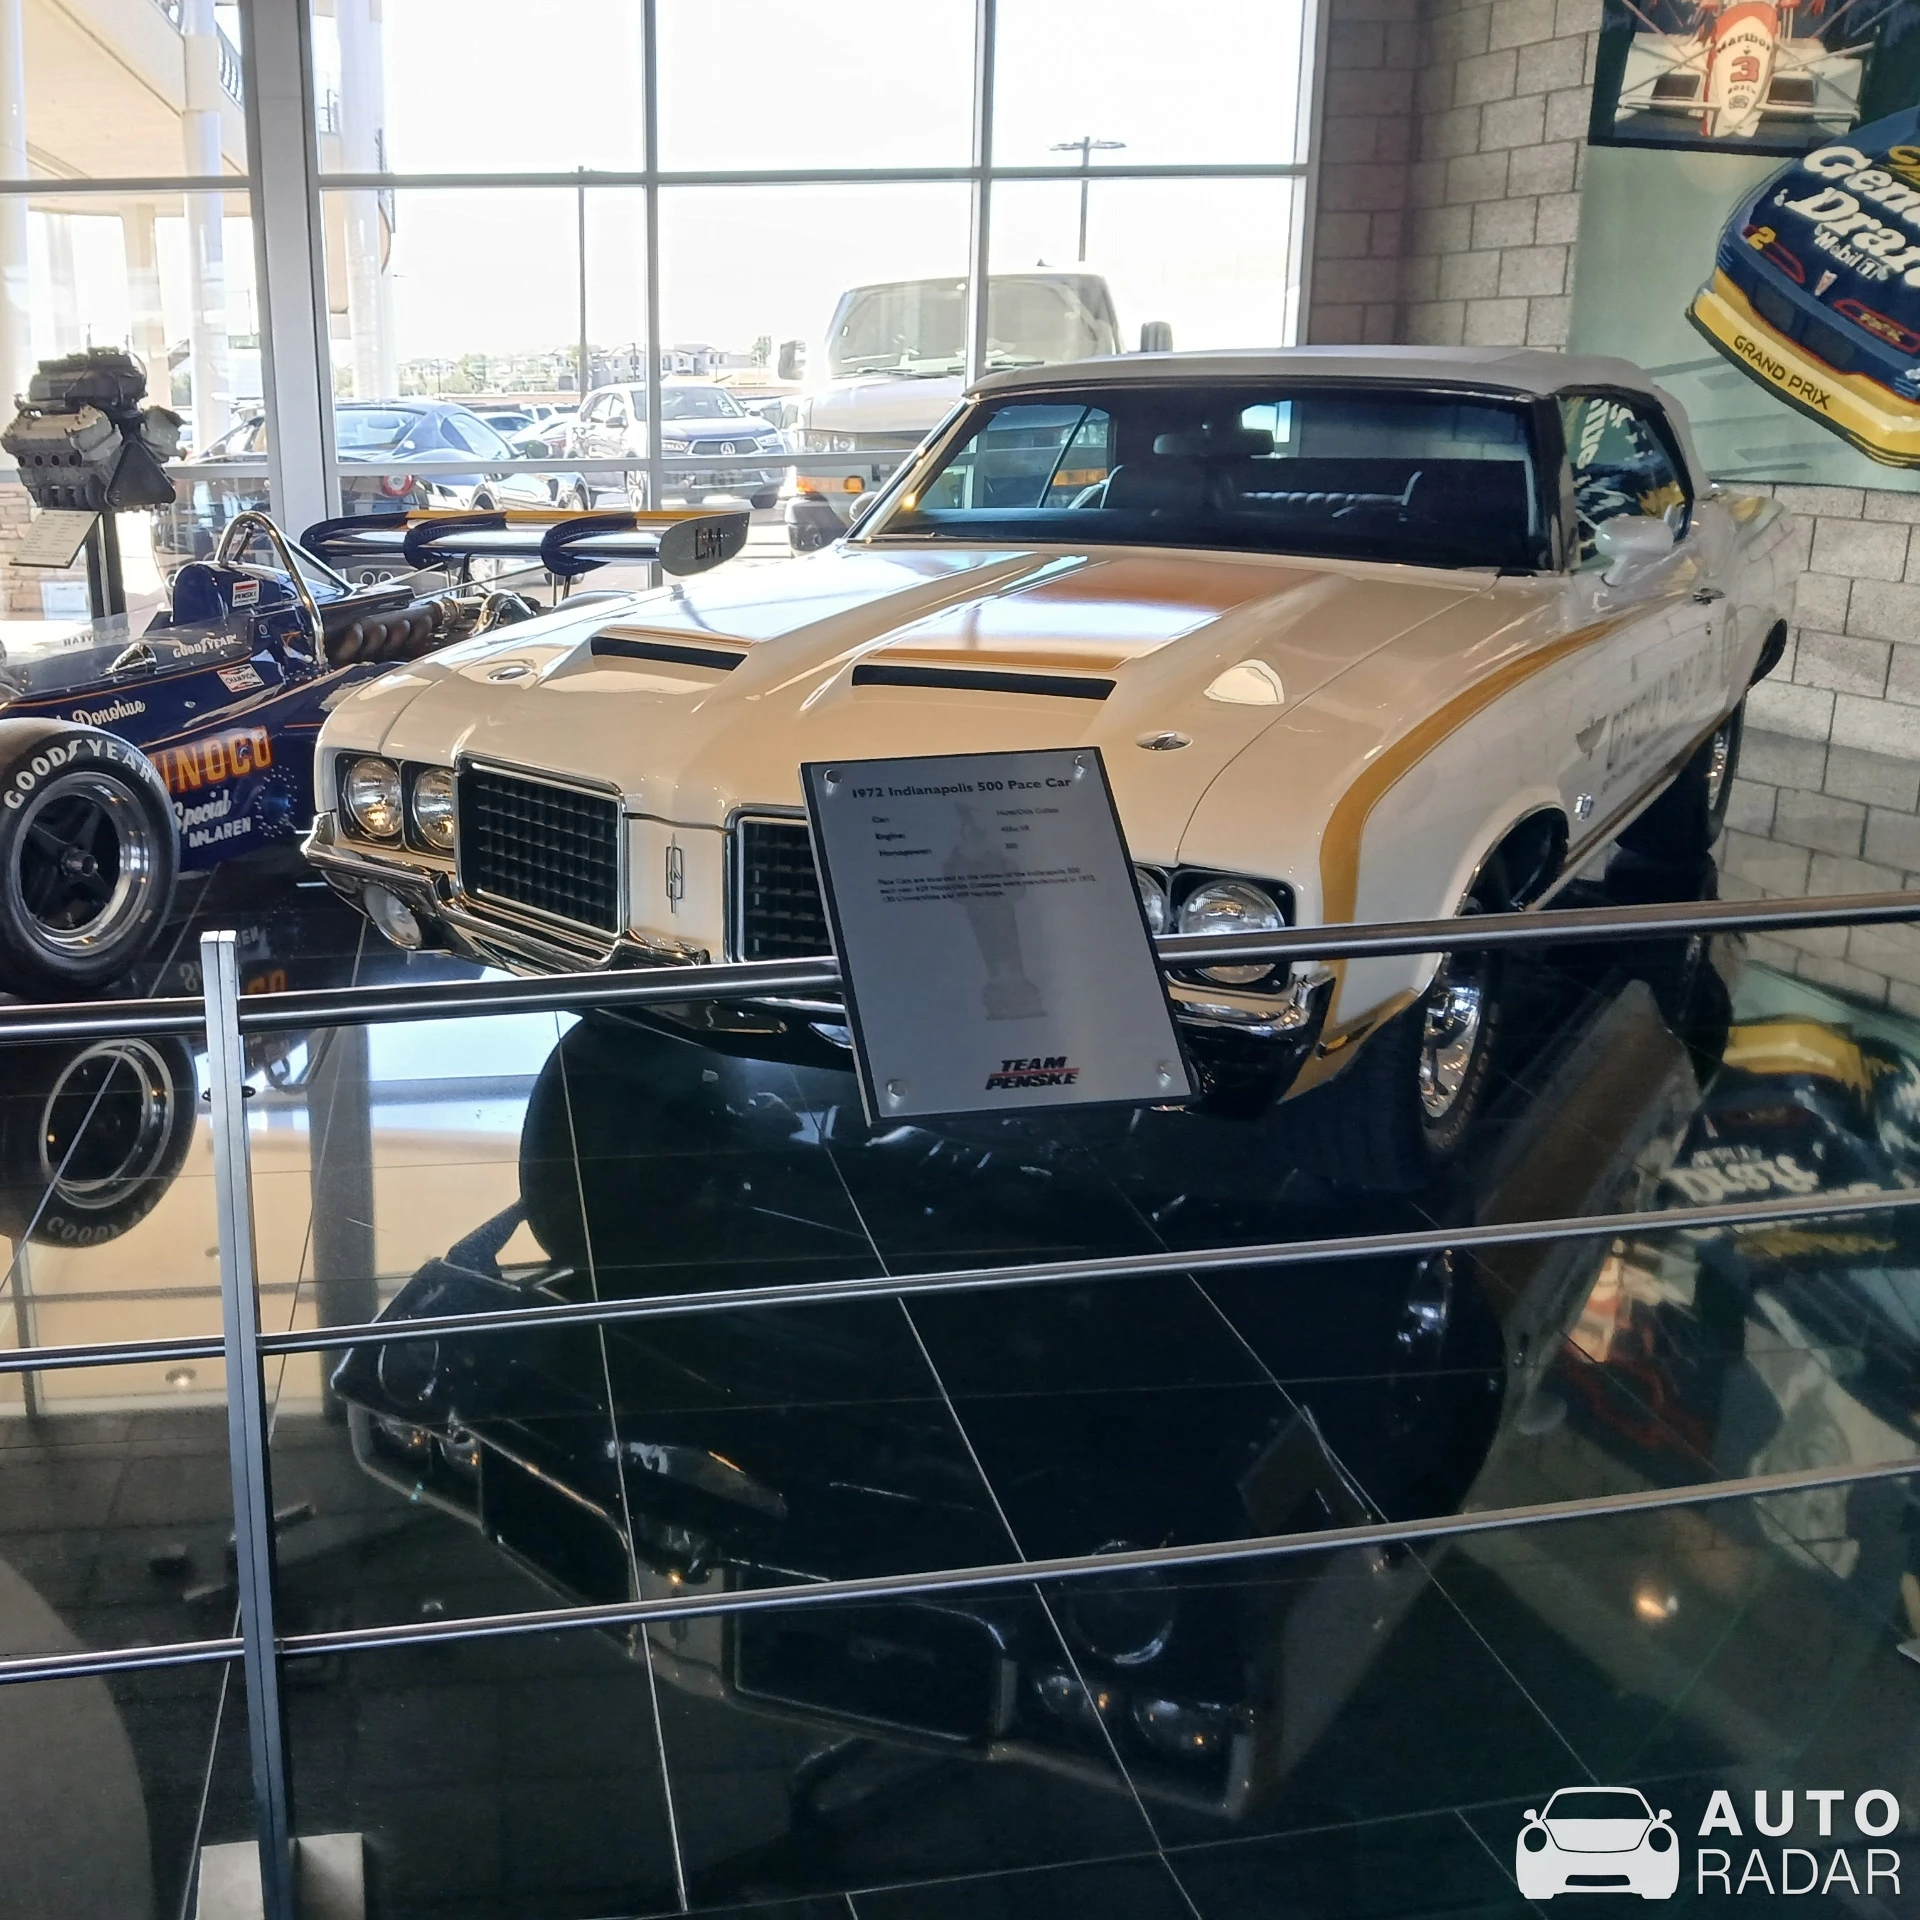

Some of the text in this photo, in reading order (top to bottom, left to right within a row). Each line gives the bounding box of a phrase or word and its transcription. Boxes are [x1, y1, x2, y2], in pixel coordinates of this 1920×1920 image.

[1729, 55, 1760, 83] 3
[1783, 186, 1920, 288] Dra
[1813, 231, 1865, 268] Mobil
[1733, 335, 1831, 411] GRAND PRIX
[173, 633, 238, 659] GOODYEAR
[72, 699, 146, 729] Donohue
[3, 737, 154, 811] GOODYEAR
[149, 727, 272, 794] UNOCO
[852, 777, 1072, 799] 1972 Indianapolis 500 Pace Car
[172, 789, 232, 835] Special
[1000, 1056, 1067, 1072] TEAM
[985, 1072, 1079, 1091] PENSKE
